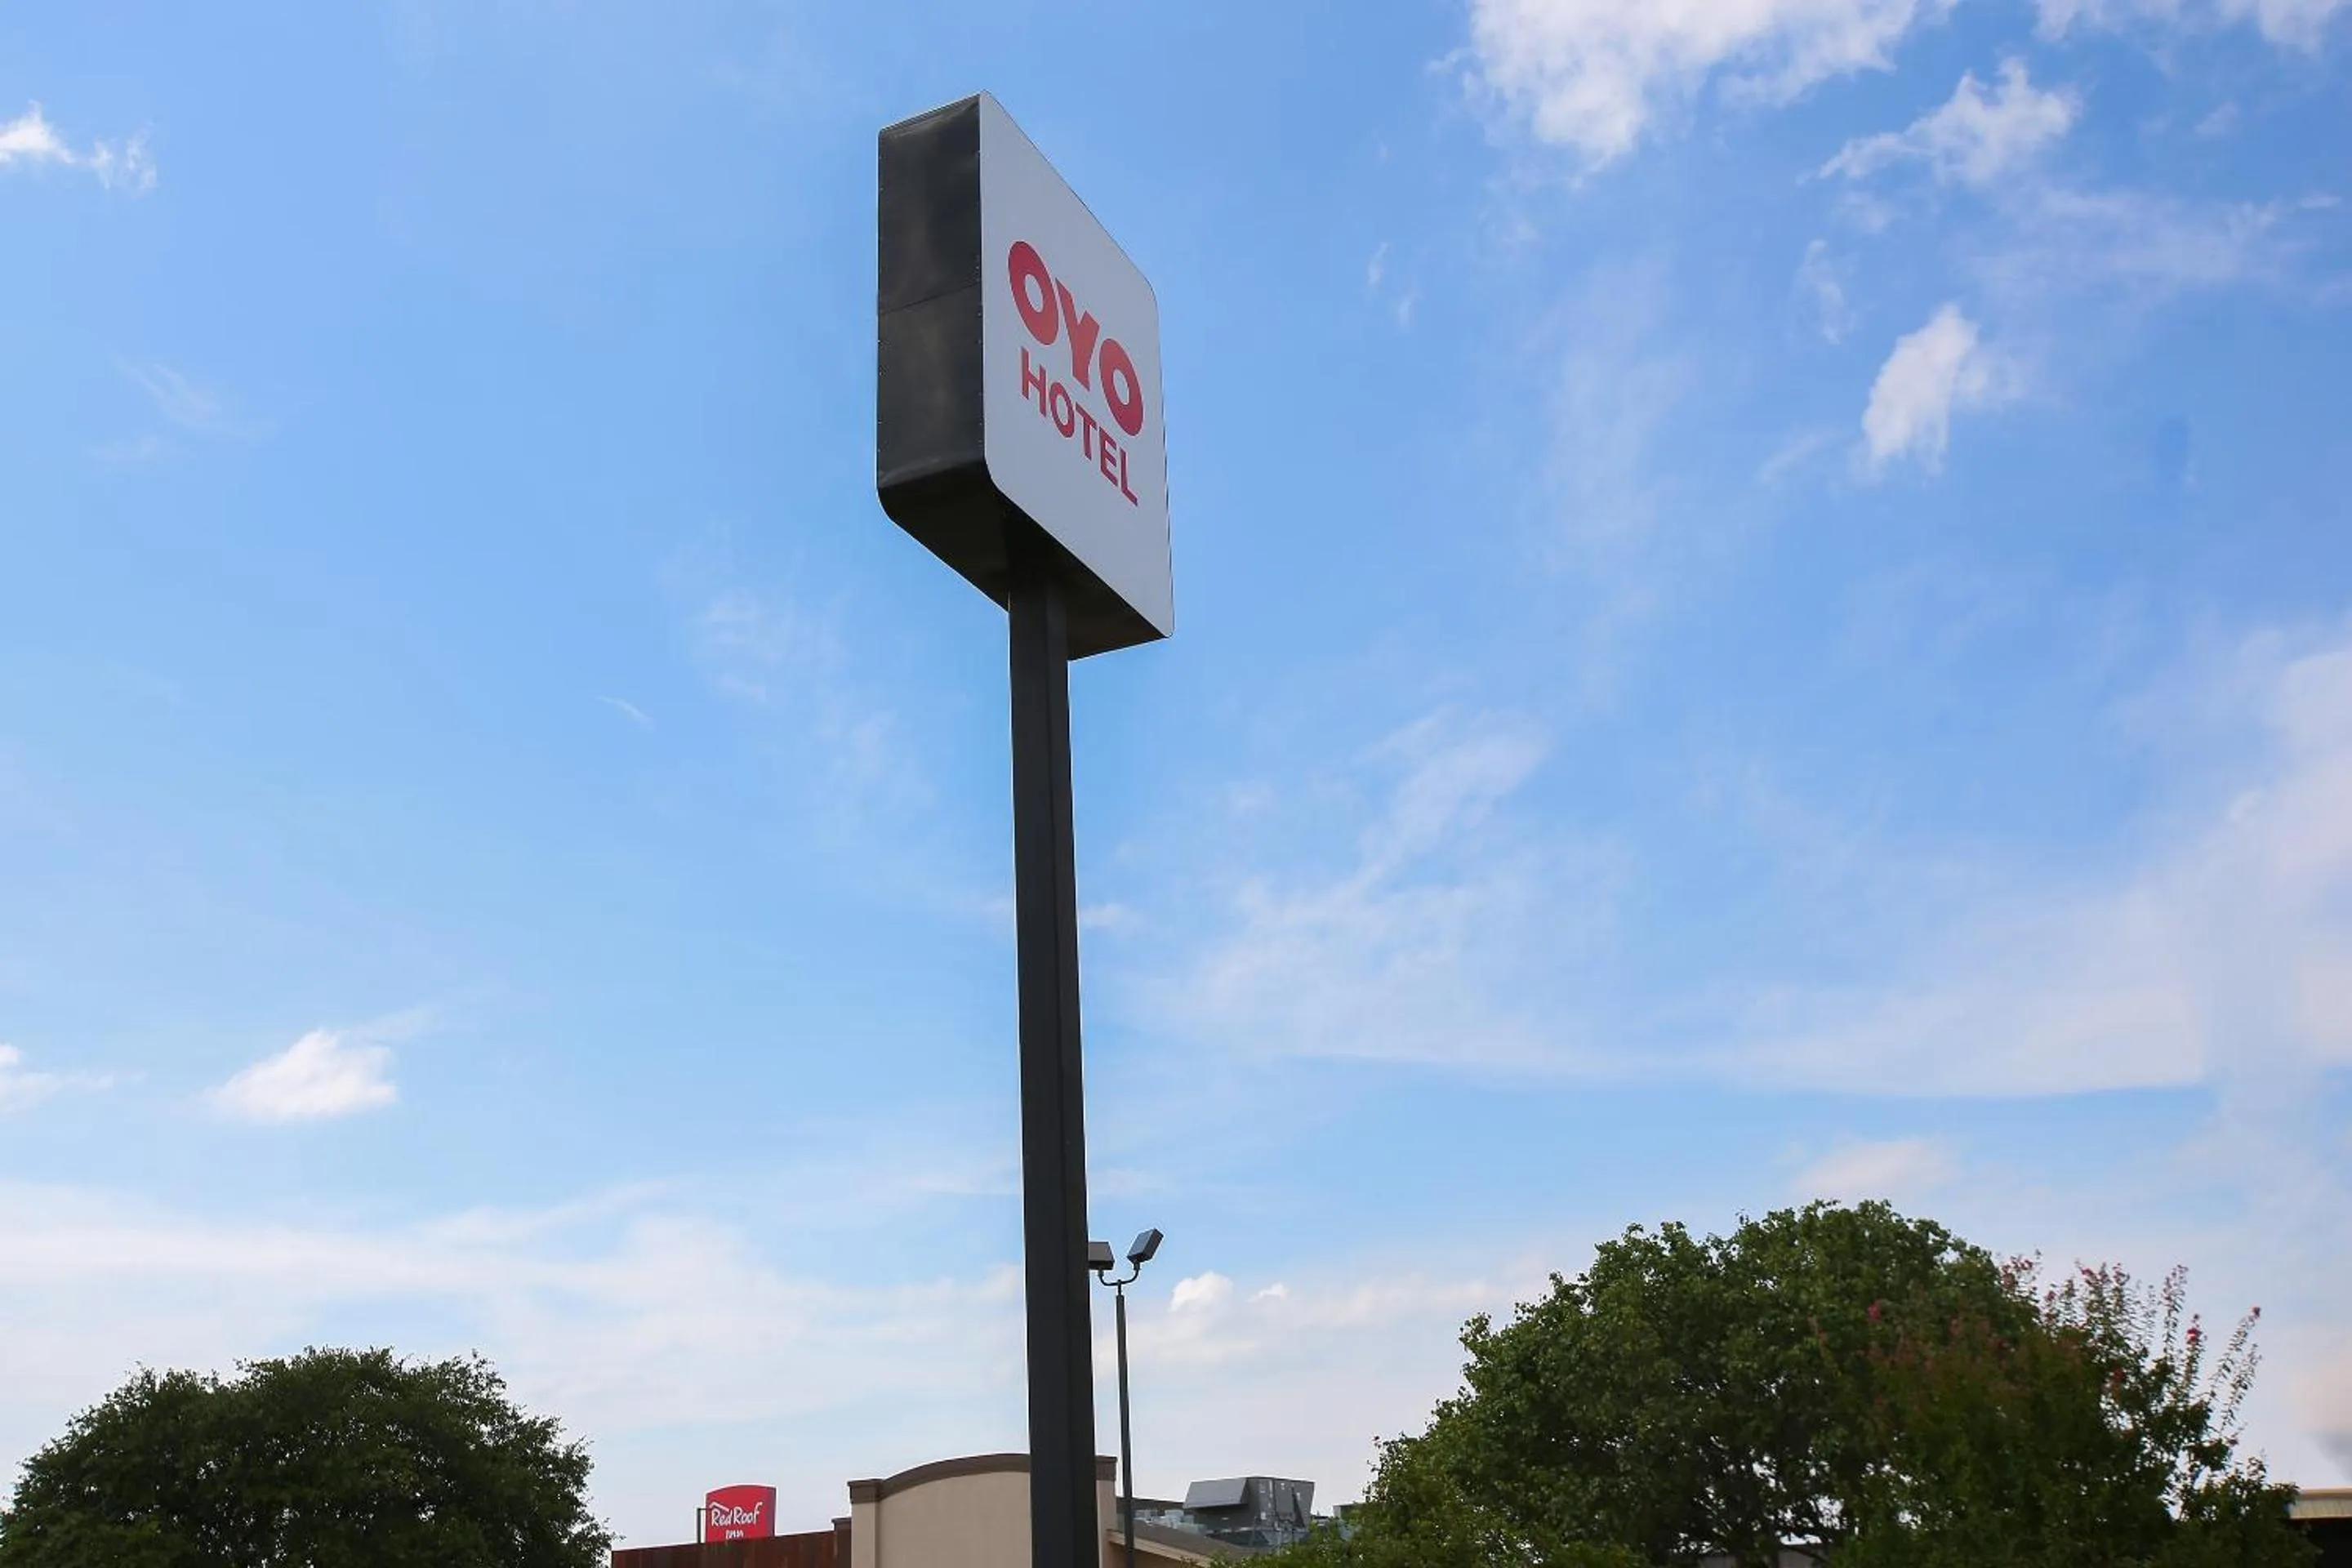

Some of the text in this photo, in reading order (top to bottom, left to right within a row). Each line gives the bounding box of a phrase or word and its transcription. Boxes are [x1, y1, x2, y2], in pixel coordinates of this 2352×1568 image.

[1008, 241, 1143, 436] OYO
[1021, 345, 1138, 506] HOTEL
[711, 1502, 763, 1526] Red Roof
